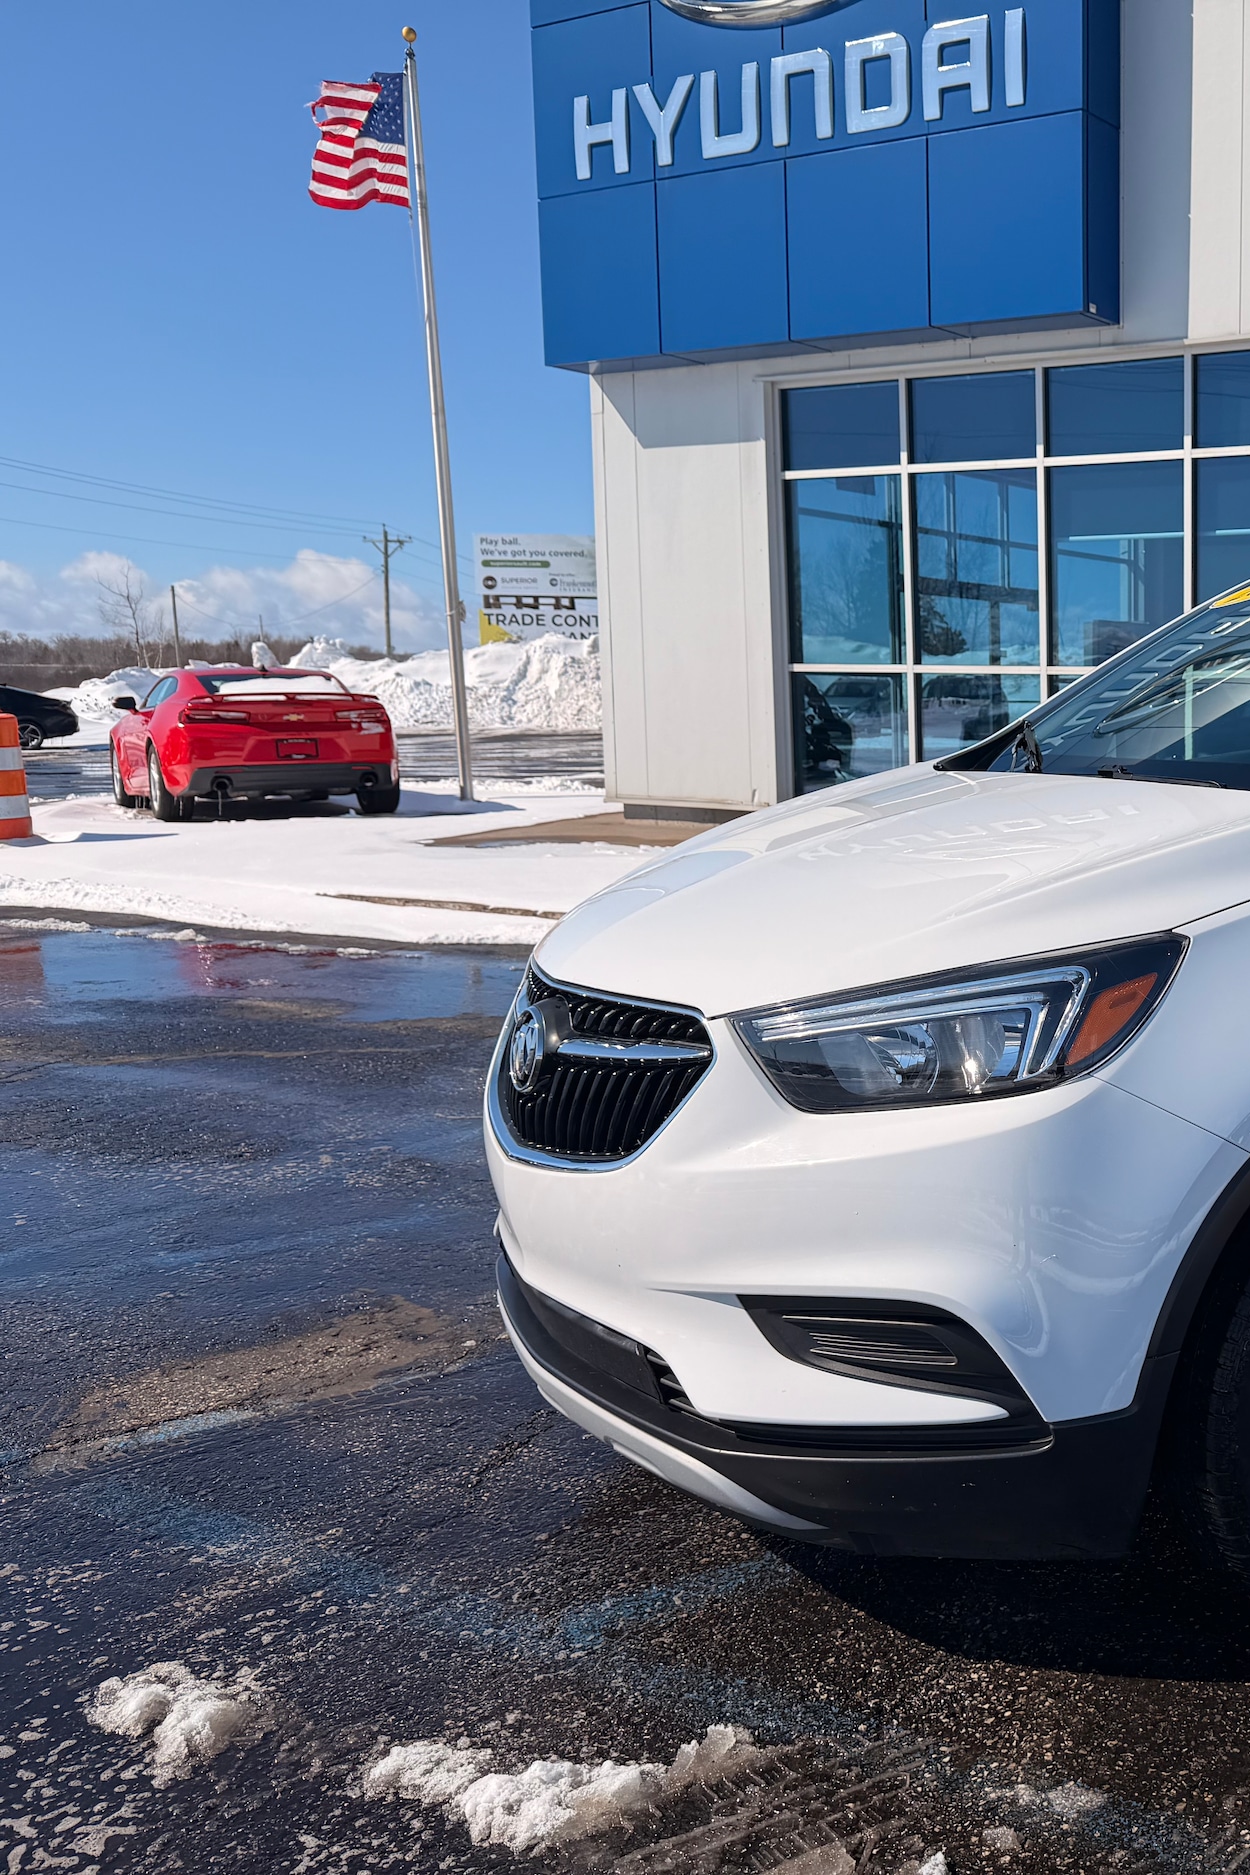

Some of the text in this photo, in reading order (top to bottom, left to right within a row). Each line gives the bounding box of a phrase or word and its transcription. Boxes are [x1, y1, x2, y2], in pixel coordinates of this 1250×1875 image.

[573, 7, 1026, 181] HYUNDAI
[480, 537, 521, 546] Play ball.
[481, 548, 588, 558] We've got you covered.
[483, 613, 599, 627] TRADE CONT
